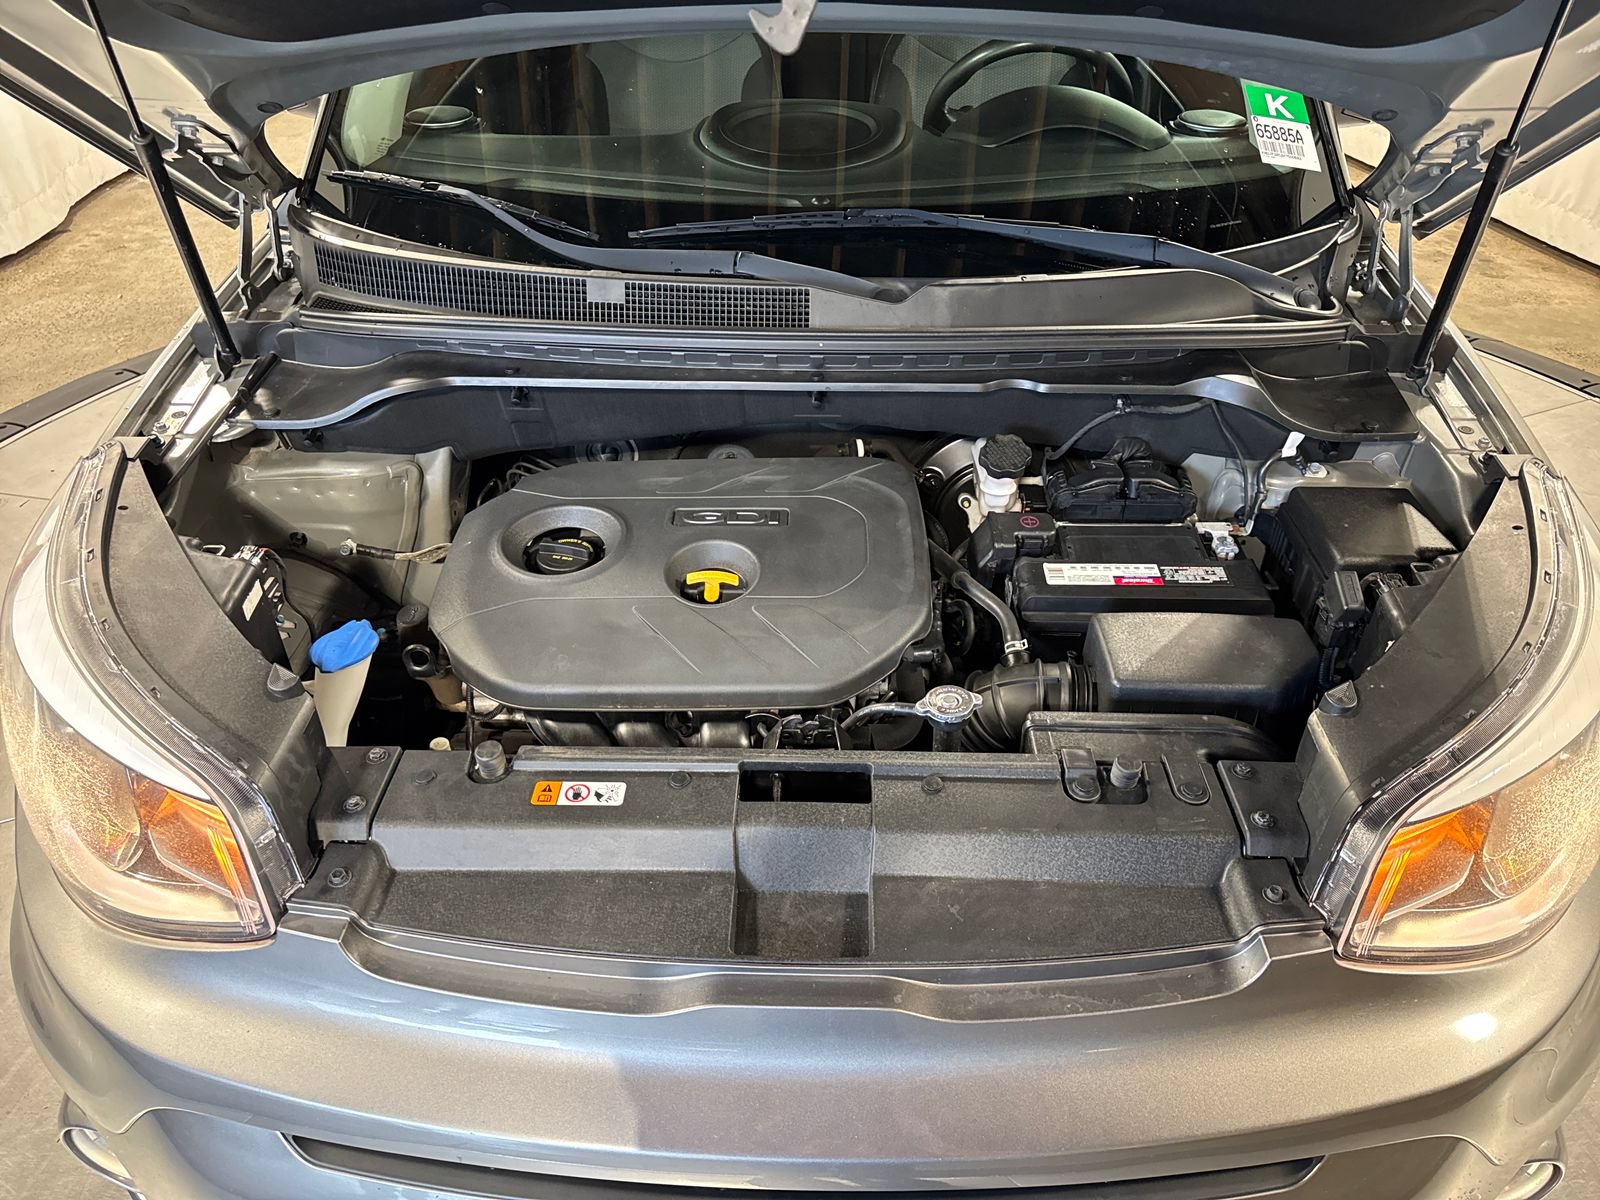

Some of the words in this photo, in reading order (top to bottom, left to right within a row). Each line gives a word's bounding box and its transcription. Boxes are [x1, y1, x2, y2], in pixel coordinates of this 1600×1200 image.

[1264, 92, 1295, 120] K
[1255, 123, 1305, 145] 65885A
[682, 511, 779, 525] GDI
